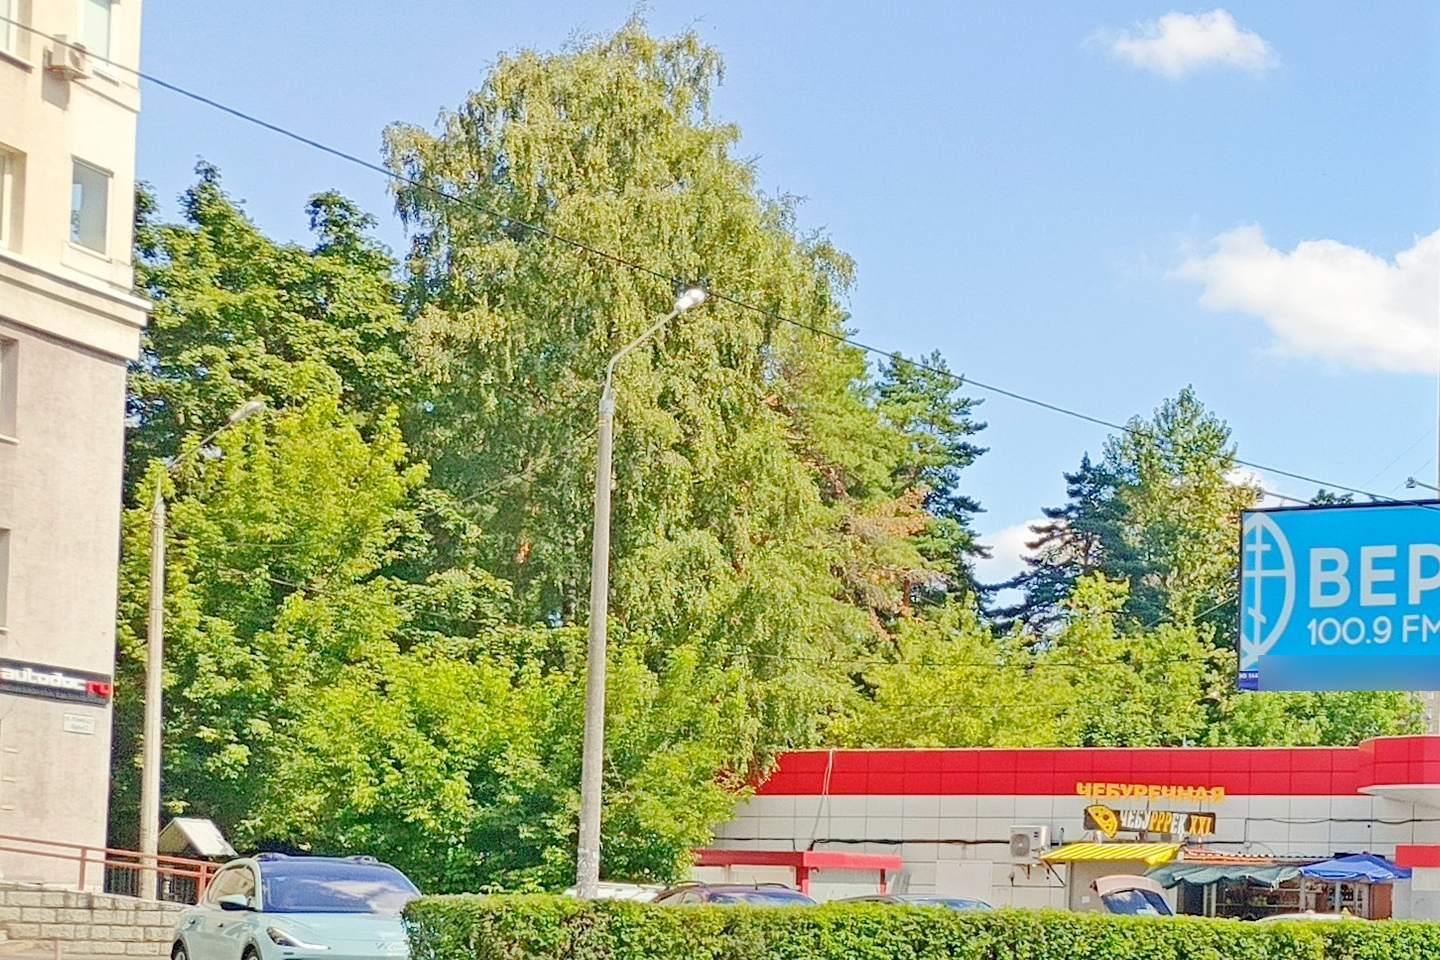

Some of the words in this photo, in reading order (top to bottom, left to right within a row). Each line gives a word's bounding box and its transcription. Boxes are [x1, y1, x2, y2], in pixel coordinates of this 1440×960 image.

[1306, 615, 1392, 646] 100.9
[1076, 782, 1225, 802] ЧЕБУРЕЧНАЯ
[1120, 809, 1187, 834] ЧЕБУРРРЕК
